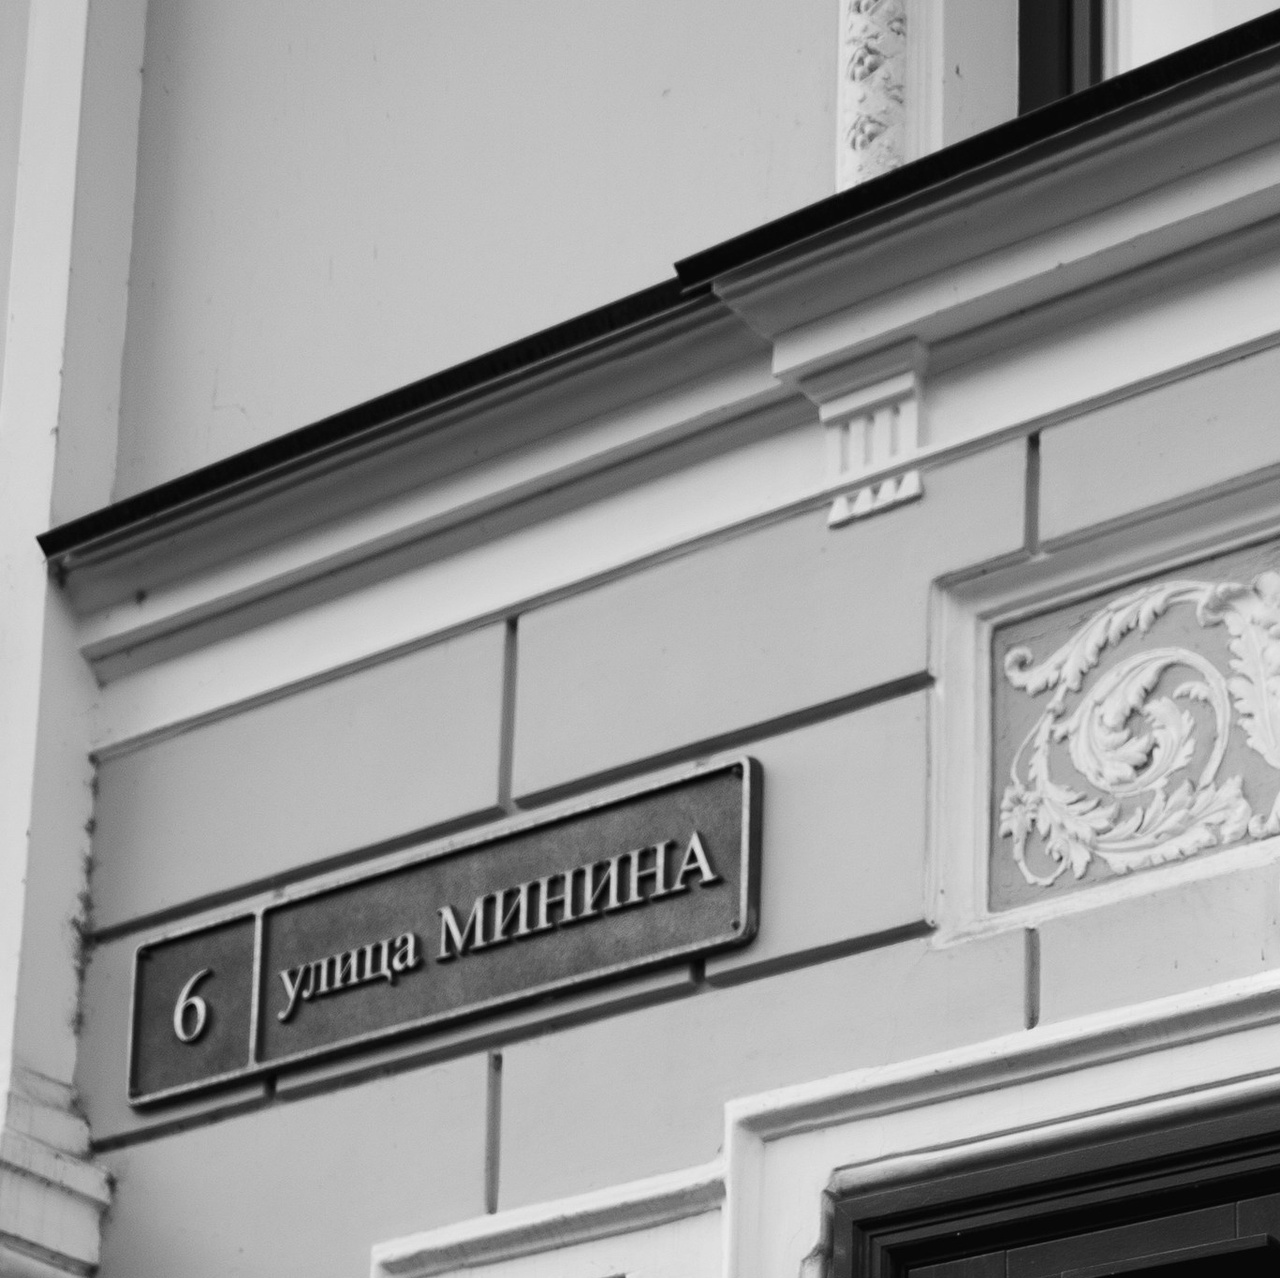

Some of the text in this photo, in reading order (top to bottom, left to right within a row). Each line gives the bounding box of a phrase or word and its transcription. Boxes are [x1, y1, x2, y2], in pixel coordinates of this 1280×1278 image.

[277, 830, 720, 1022] улица МИНИНА
[172, 968, 213, 1044] 6
